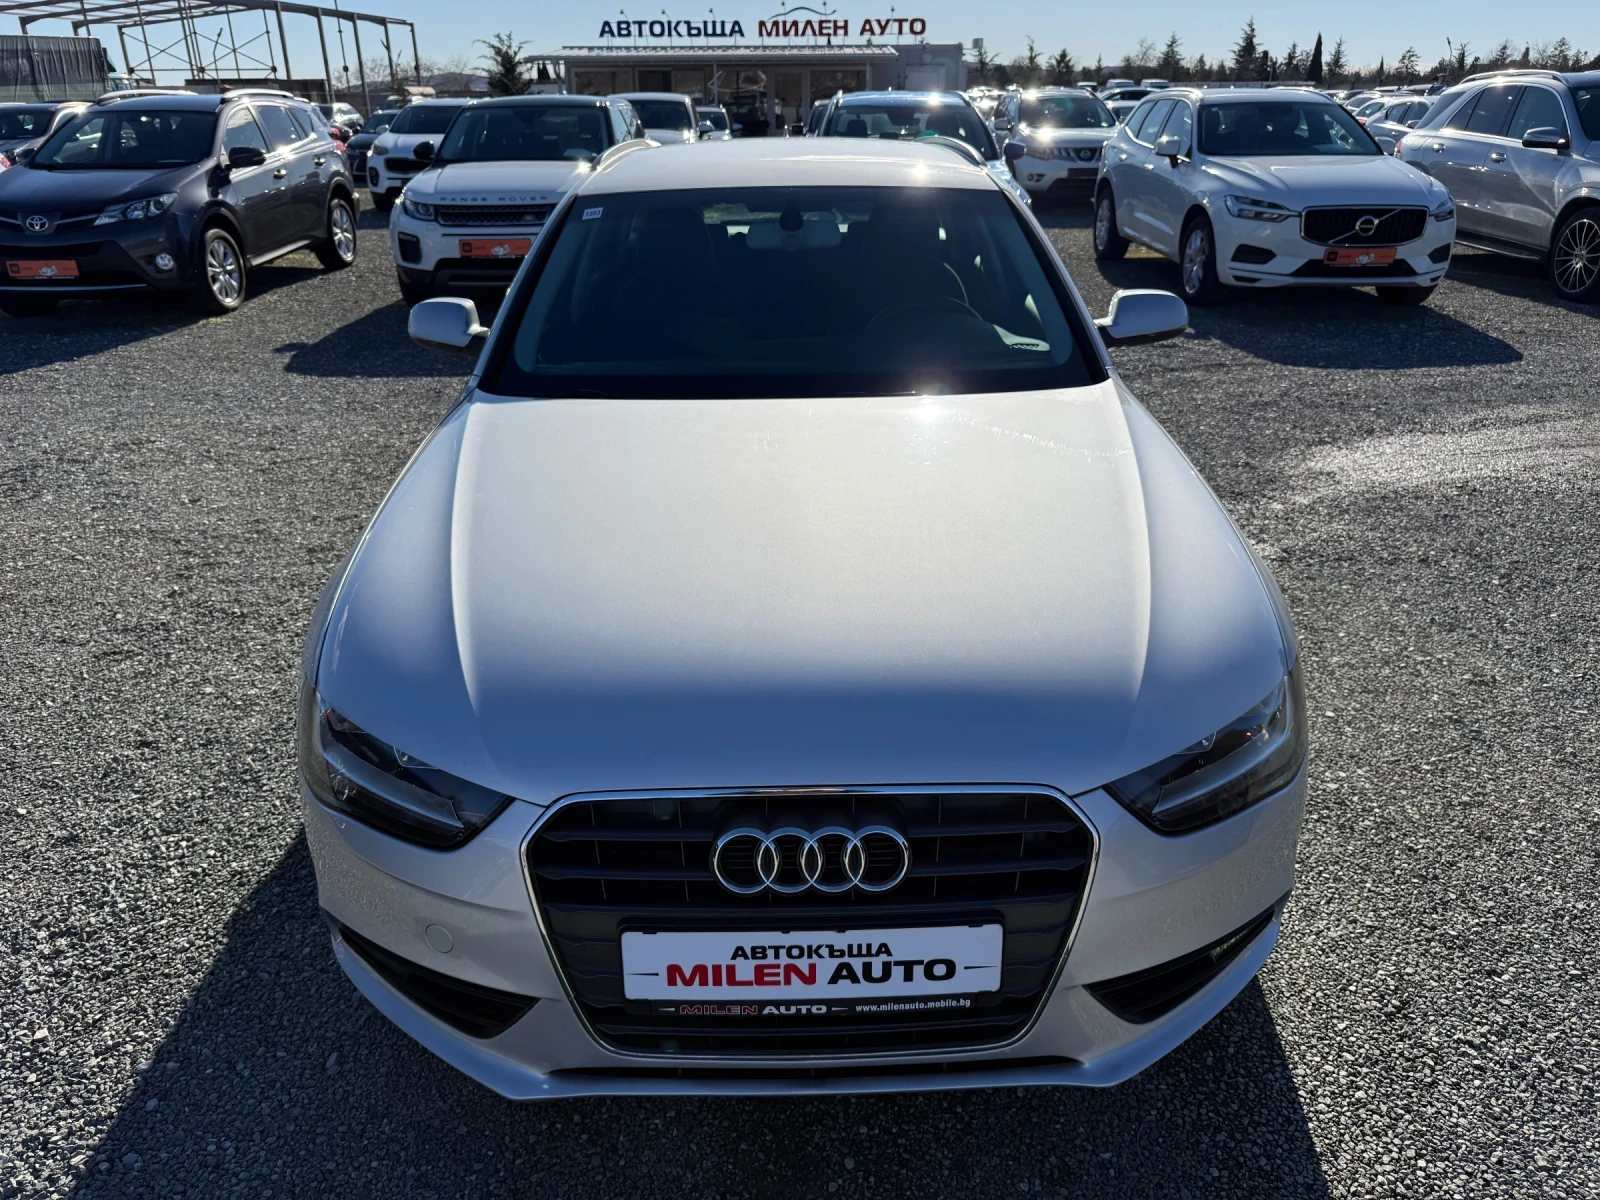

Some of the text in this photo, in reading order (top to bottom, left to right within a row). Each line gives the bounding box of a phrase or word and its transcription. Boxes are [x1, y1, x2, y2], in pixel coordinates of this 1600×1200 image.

[599, 18, 927, 37] АВТОКЪЩА МИЛЕН АУТО
[730, 942, 894, 960] АВТОКЪЩА
[666, 958, 957, 987] MILEN AUTO
[680, 998, 971, 1014] MILEN AUTO www.milenauto.mobile.bg
